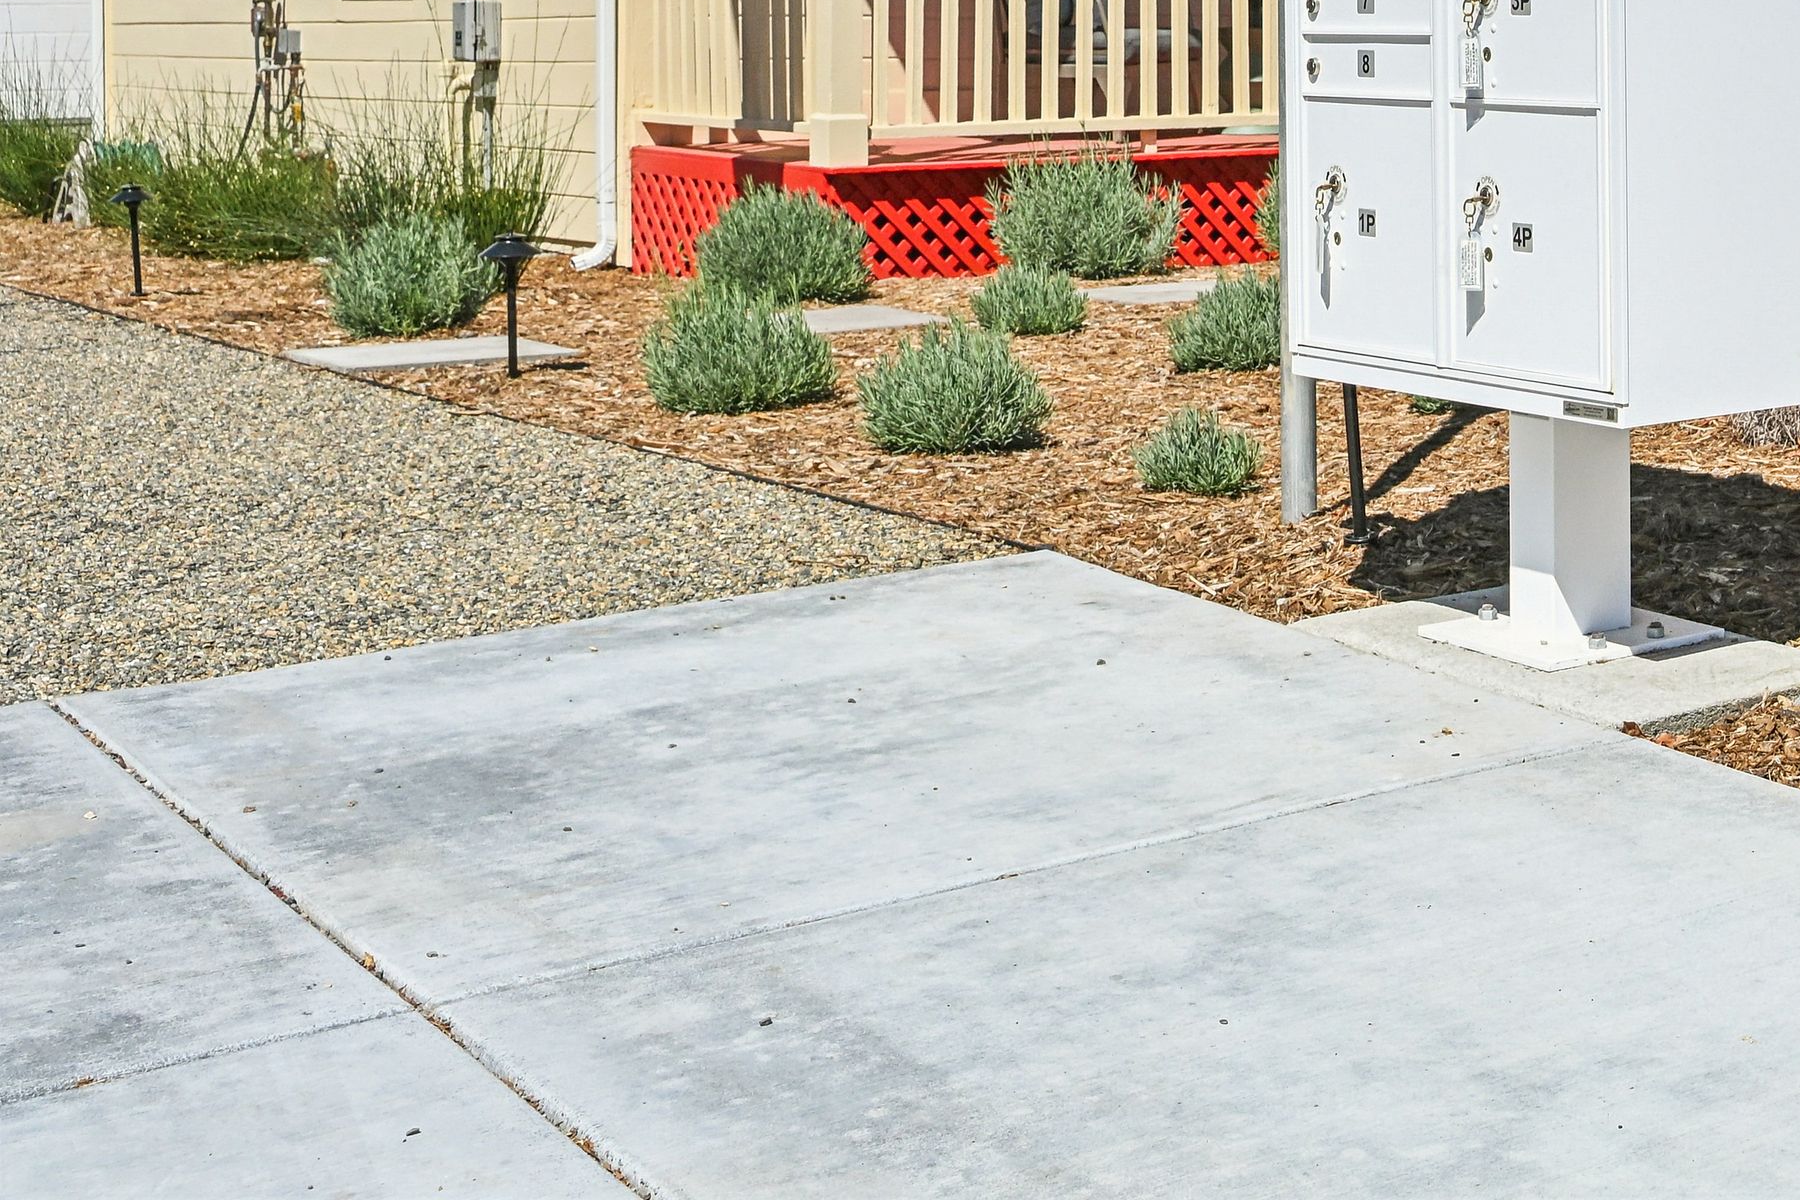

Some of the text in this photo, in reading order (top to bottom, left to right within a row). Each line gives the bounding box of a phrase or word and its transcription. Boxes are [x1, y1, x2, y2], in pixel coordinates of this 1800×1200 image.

[1362, 54, 1370, 74] 8
[1359, 213, 1376, 233] 1P
[1513, 227, 1533, 248] 4P
